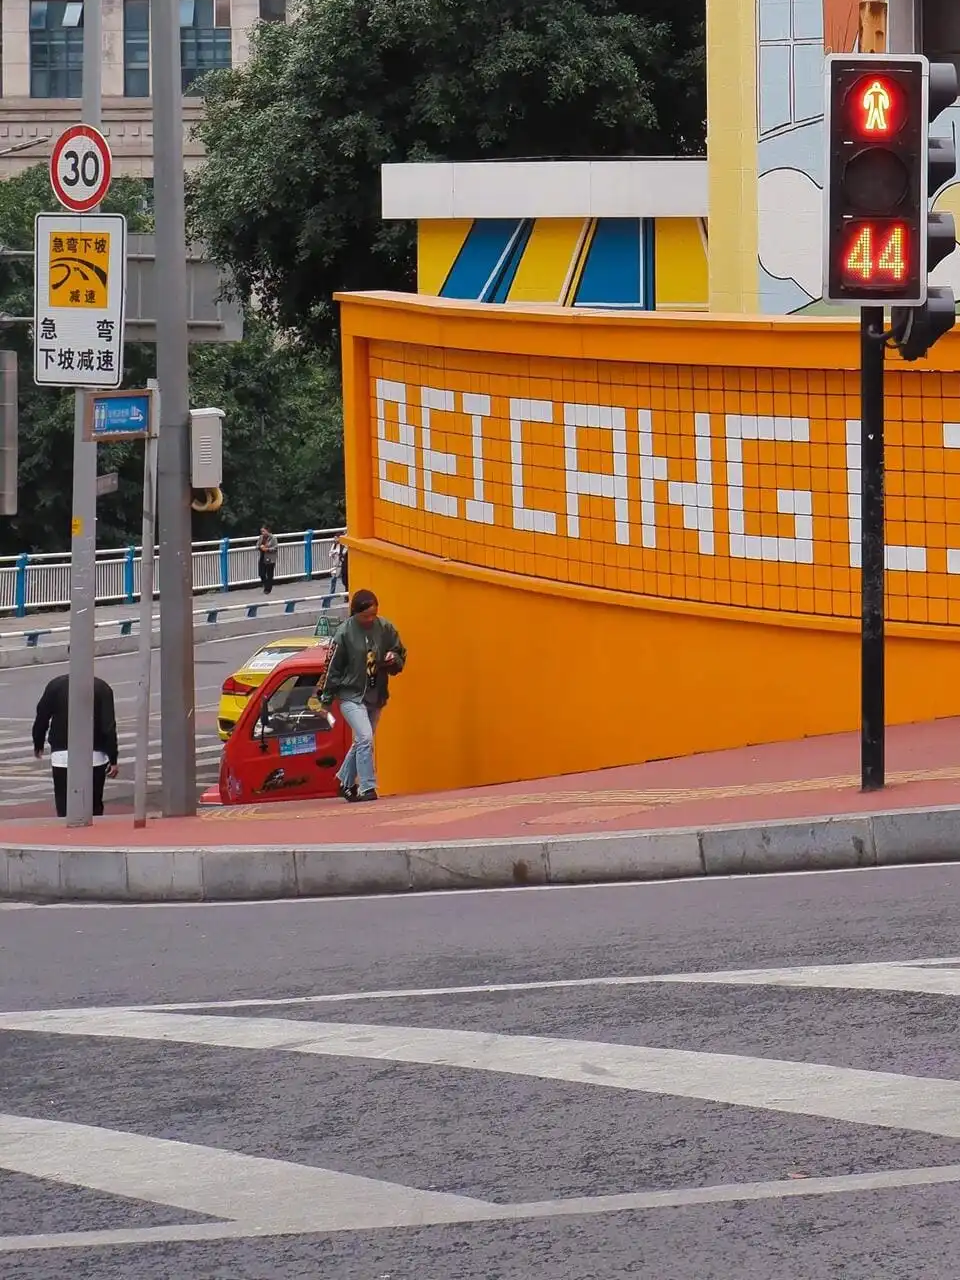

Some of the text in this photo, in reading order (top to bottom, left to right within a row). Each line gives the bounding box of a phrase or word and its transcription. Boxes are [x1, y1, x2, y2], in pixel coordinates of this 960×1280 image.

[63, 150, 99, 187] 30
[52, 237, 107, 254] 急弯下坡
[847, 227, 904, 279] 44
[39, 347, 114, 372] 下坡减速
